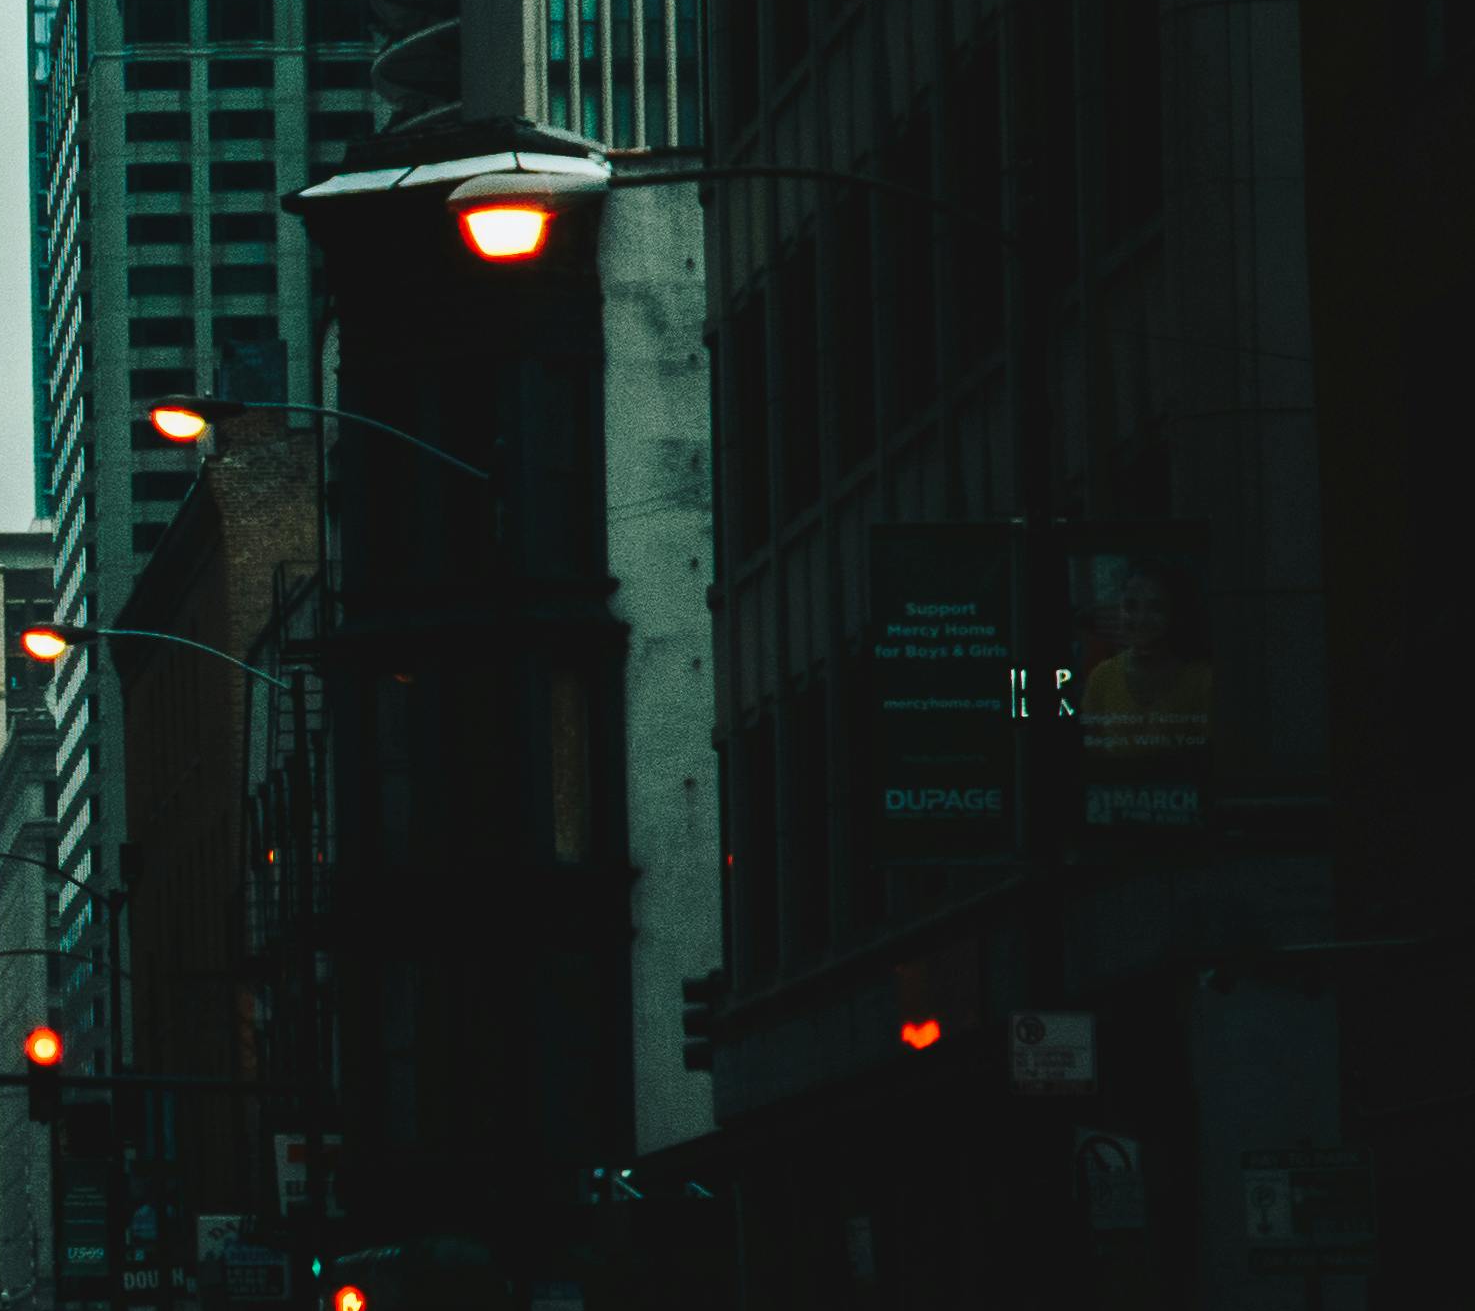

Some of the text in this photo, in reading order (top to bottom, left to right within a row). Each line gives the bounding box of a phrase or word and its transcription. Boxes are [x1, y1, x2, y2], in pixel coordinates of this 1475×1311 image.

[904, 600, 979, 620] Support
[886, 623, 998, 641] Mercy Home
[874, 644, 902, 659] for
[904, 644, 950, 661] Boys
[968, 644, 1010, 660] Girls
[882, 696, 1004, 714] mercyhome.org
[884, 788, 1004, 812] DUPAGE
[1113, 787, 1200, 811] MARCH
